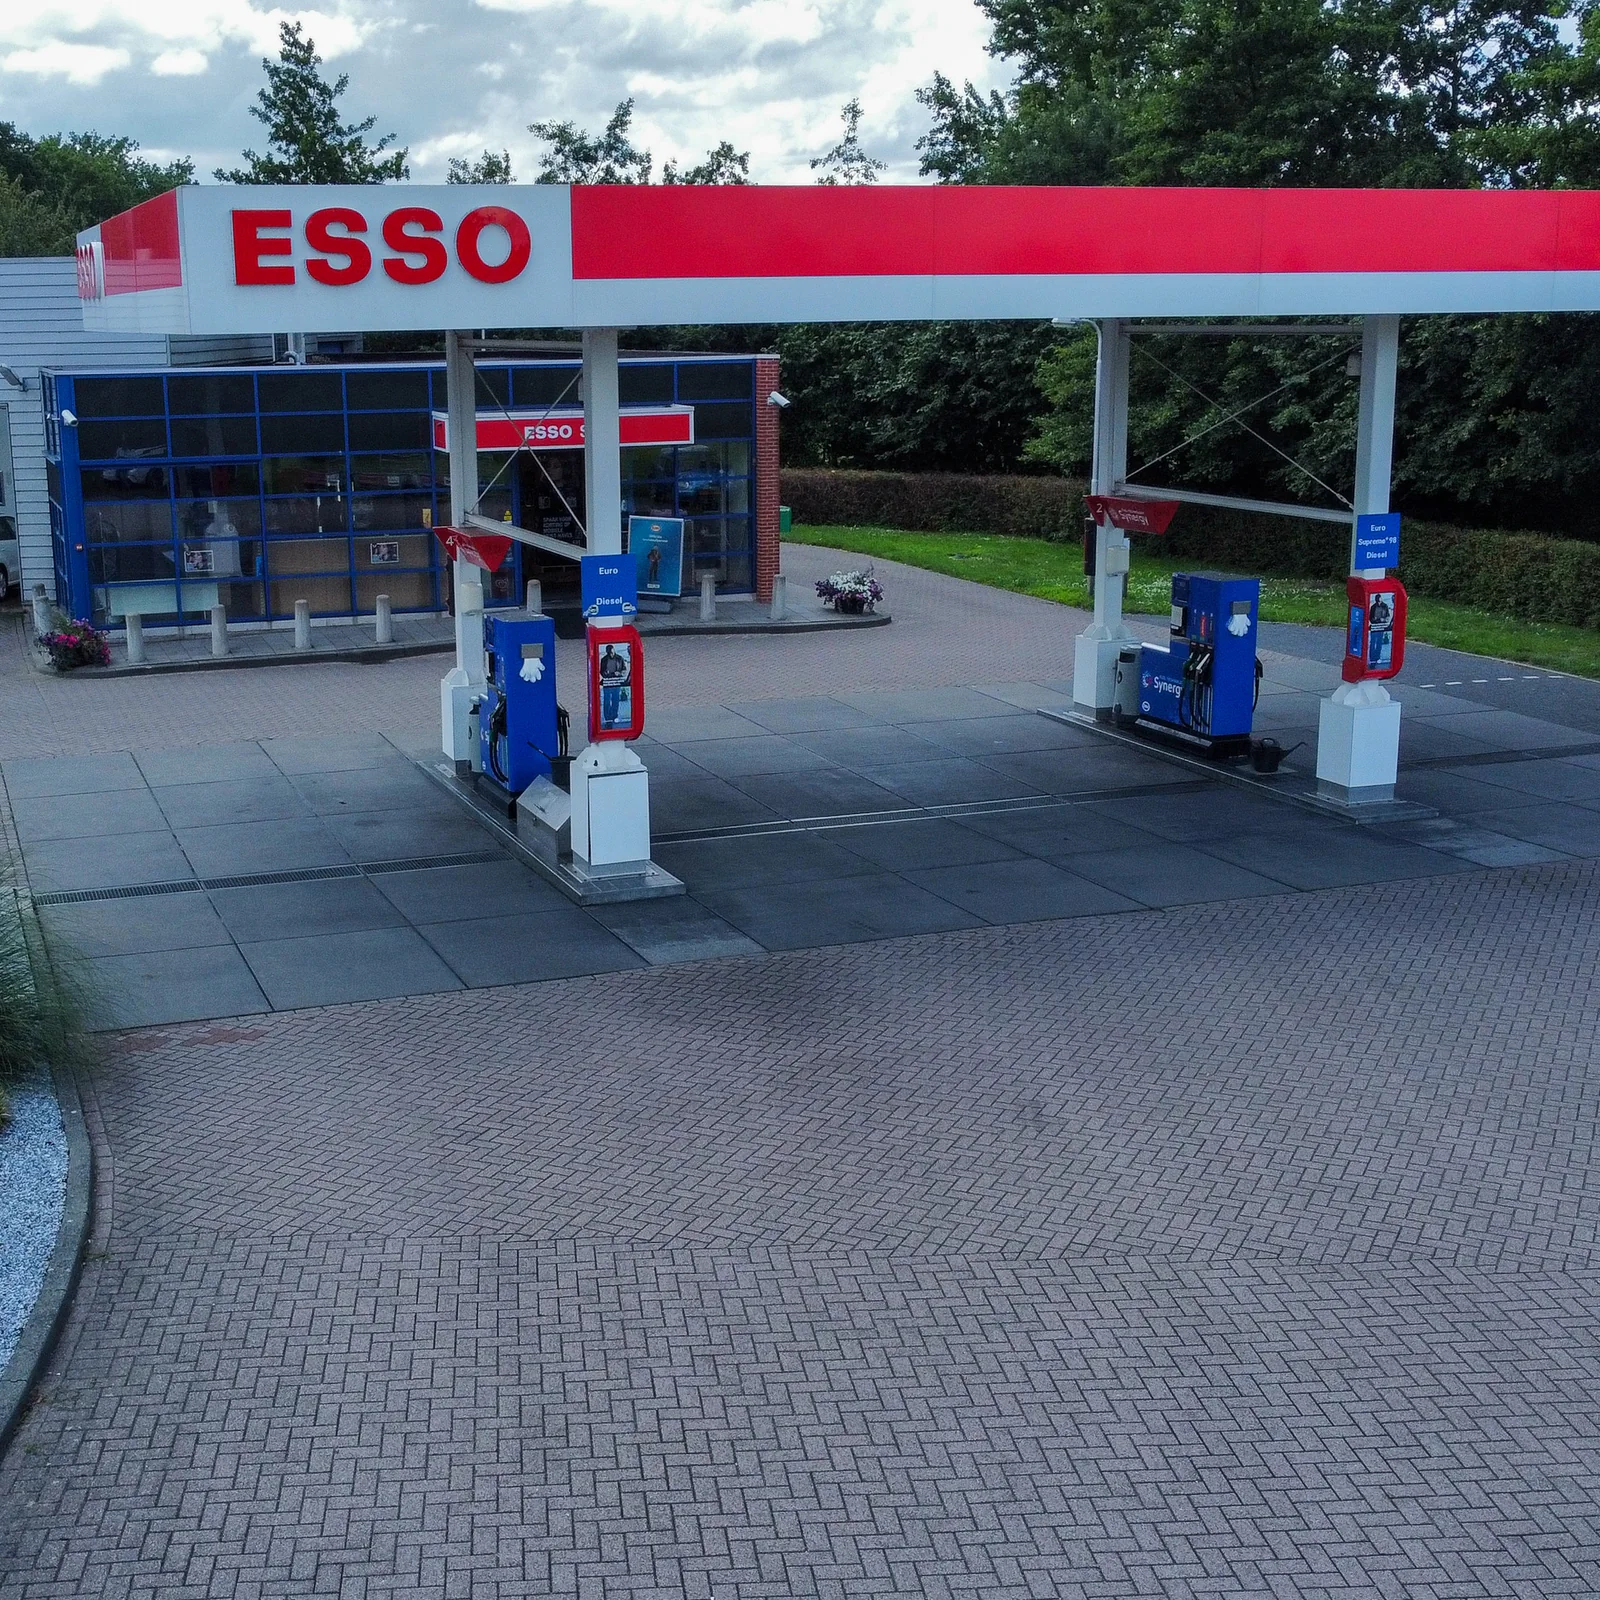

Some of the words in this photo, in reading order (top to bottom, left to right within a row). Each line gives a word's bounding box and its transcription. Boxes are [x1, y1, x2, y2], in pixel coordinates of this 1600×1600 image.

[231, 205, 531, 285] ESSO
[524, 425, 573, 439] ESSO
[1096, 503, 1103, 513] 2
[446, 536, 454, 547] 4
[599, 567, 619, 575] Euro
[596, 596, 622, 605] Diesel
